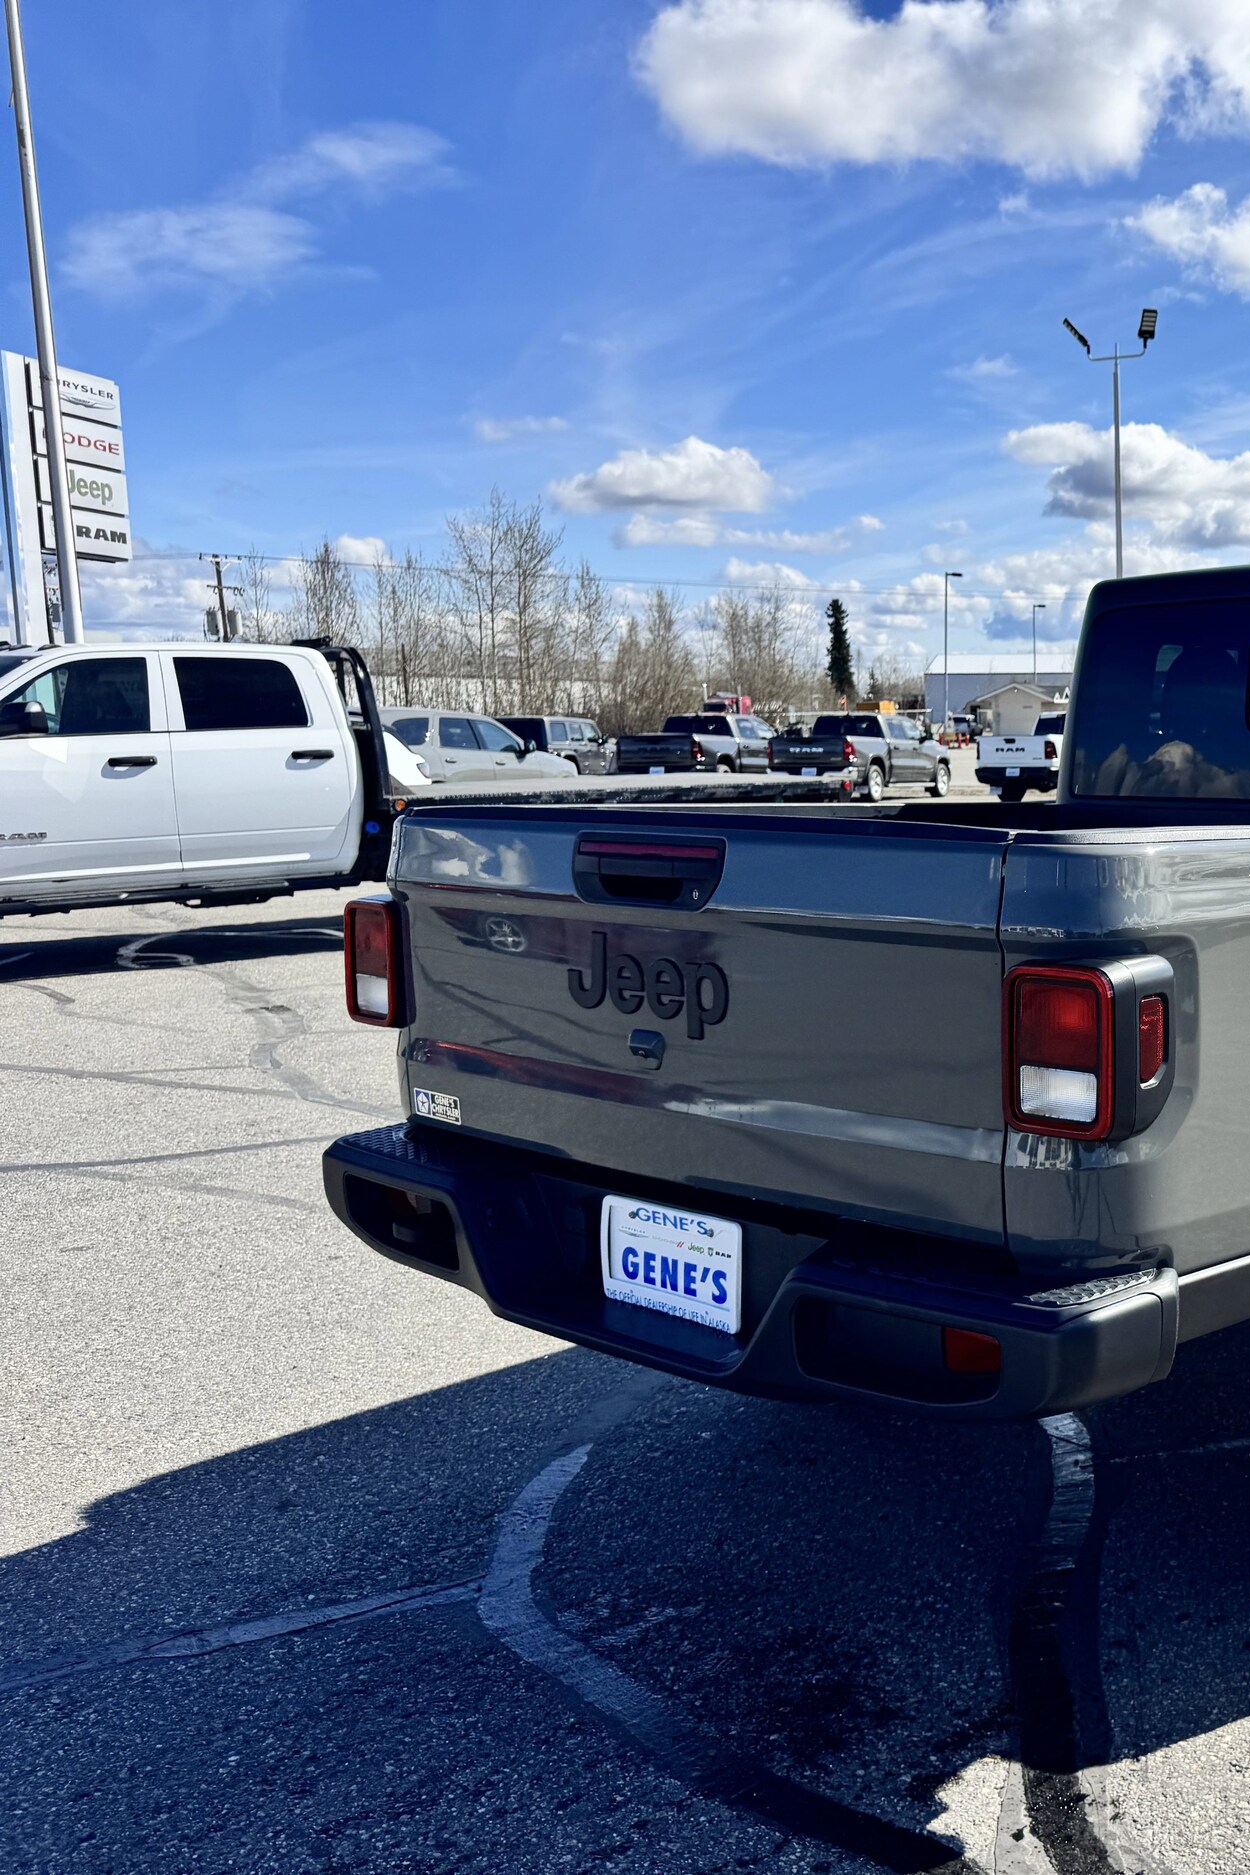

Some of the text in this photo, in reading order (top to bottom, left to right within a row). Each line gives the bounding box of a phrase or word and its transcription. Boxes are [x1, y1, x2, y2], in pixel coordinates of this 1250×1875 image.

[57, 379, 114, 401] RYSLER
[62, 432, 120, 456] ODGE
[76, 524, 127, 544] RAM
[567, 930, 729, 1040] Jeep
[635, 1207, 708, 1236] GENE'S
[621, 1246, 728, 1305] GENE'S
